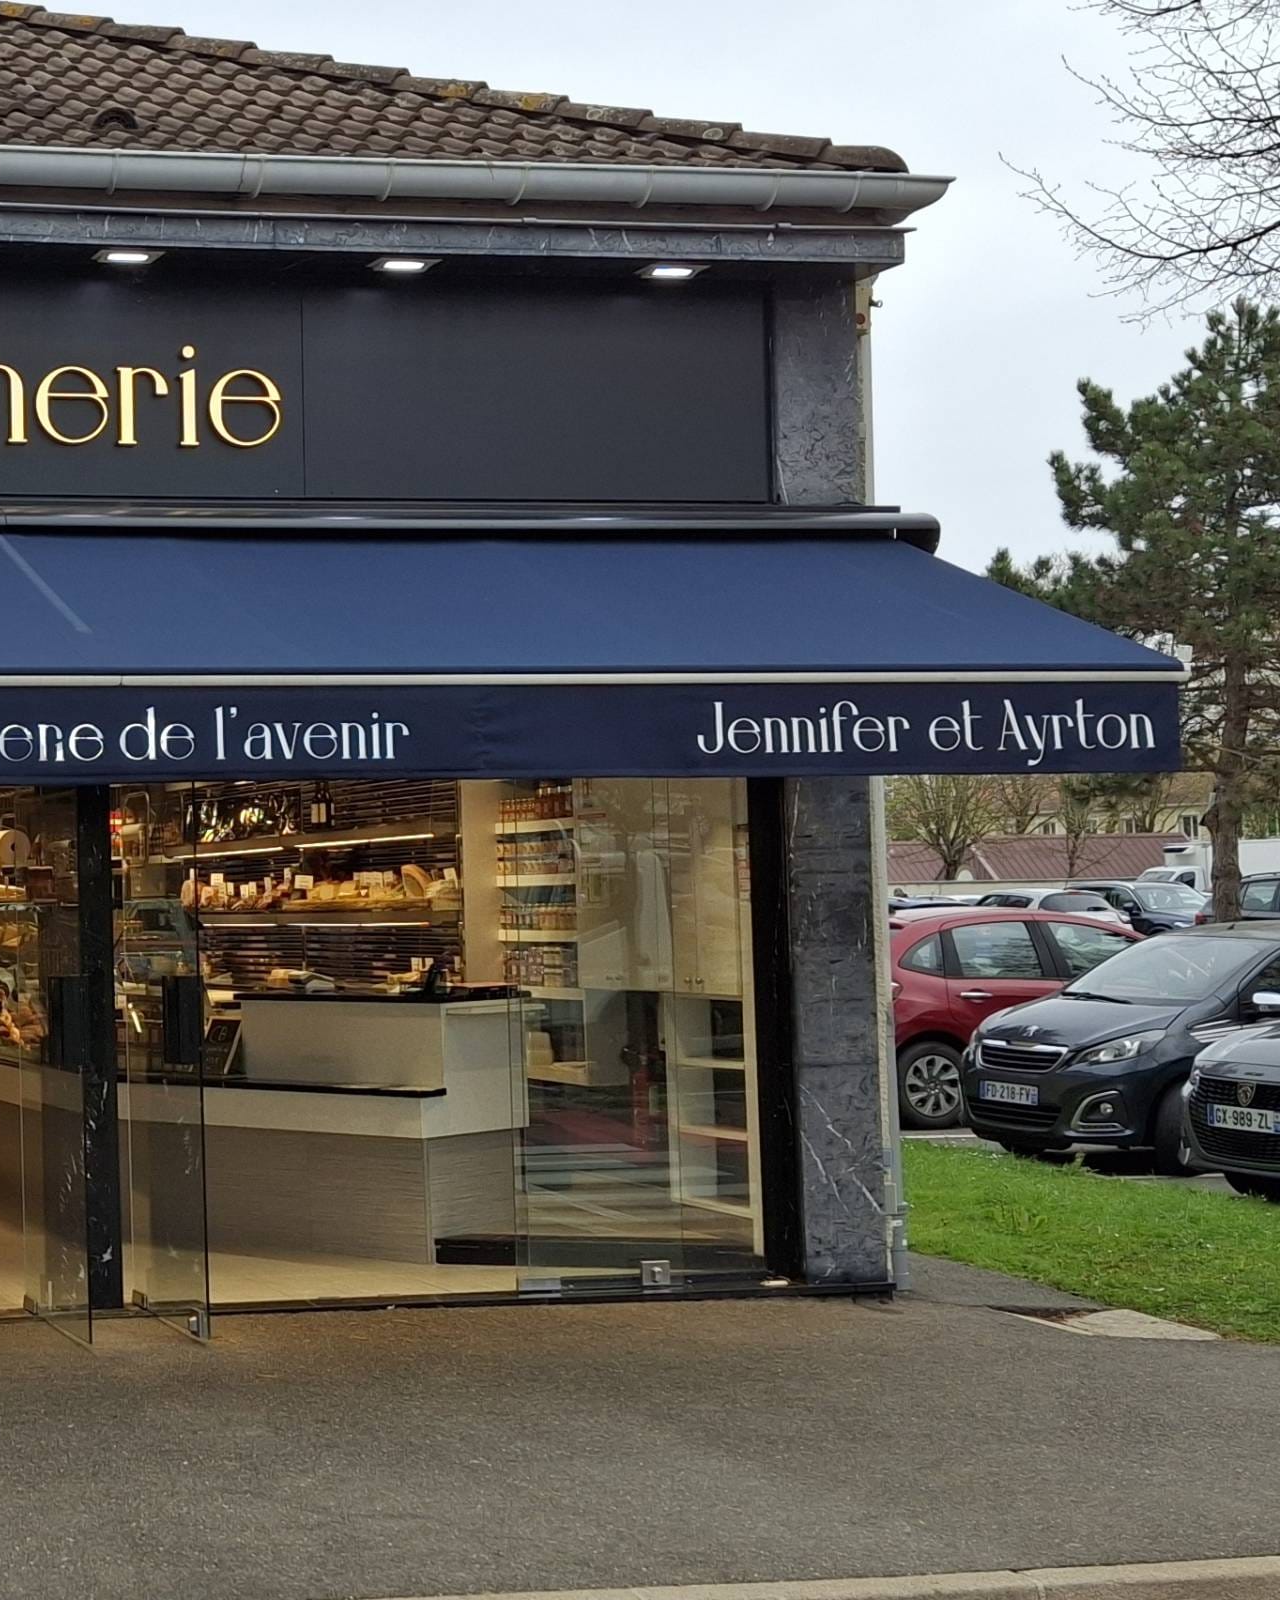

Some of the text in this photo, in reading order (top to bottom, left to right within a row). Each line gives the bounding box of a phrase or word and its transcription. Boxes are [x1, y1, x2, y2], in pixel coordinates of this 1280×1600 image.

[120, 707, 195, 760] de
[215, 707, 410, 759] l'avenir
[698, 699, 1156, 766] Jennifer et Ayrton
[1215, 1107, 1273, 1130] GX-989-ZL
